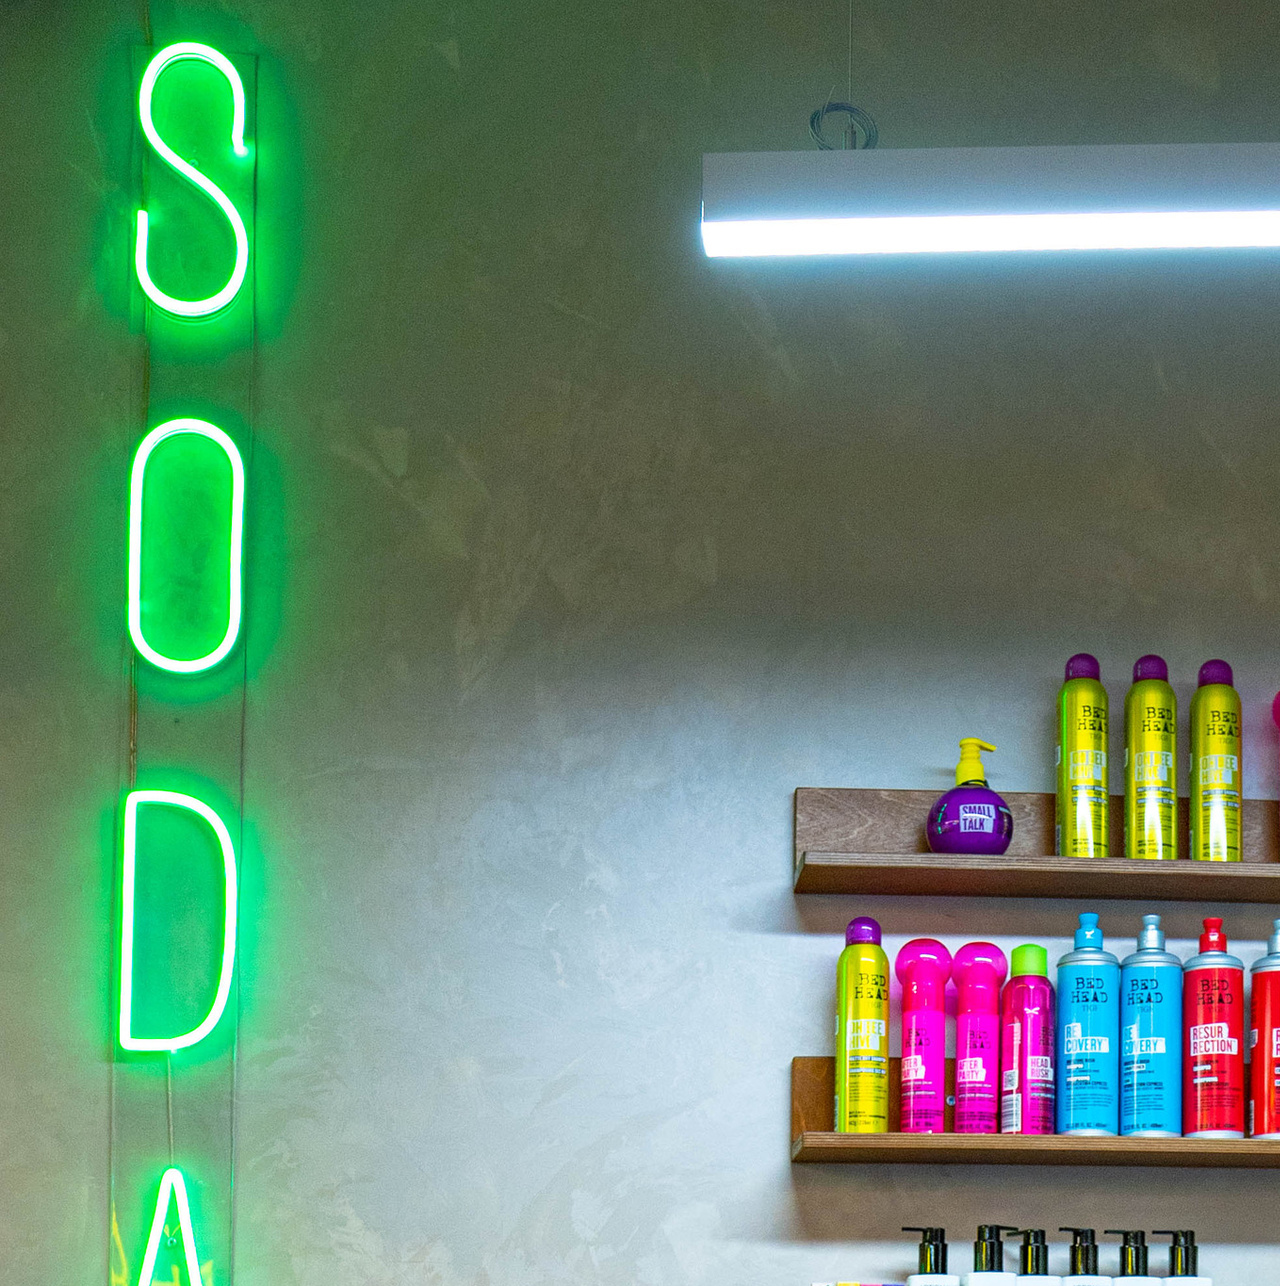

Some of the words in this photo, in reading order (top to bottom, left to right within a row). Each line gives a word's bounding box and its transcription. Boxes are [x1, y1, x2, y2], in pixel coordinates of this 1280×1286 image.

[1146, 706, 1173, 719] BED
[1211, 711, 1237, 723] BED
[962, 805, 993, 819] SMALL
[962, 818, 986, 831] TALK
[858, 973, 886, 986] BED
[1075, 977, 1104, 989] BED
[1130, 979, 1159, 991] BED
[1201, 980, 1229, 991] BED
[855, 987, 888, 1000] HEAD
[1071, 992, 1108, 1003] HEAD
[1127, 993, 1163, 1005] HEAD
[1197, 993, 1233, 1005] HEAD
[1193, 1026, 1223, 1039] RESUR
[1031, 1058, 1049, 1068] HEAD
[958, 1071, 980, 1082] PARTY
